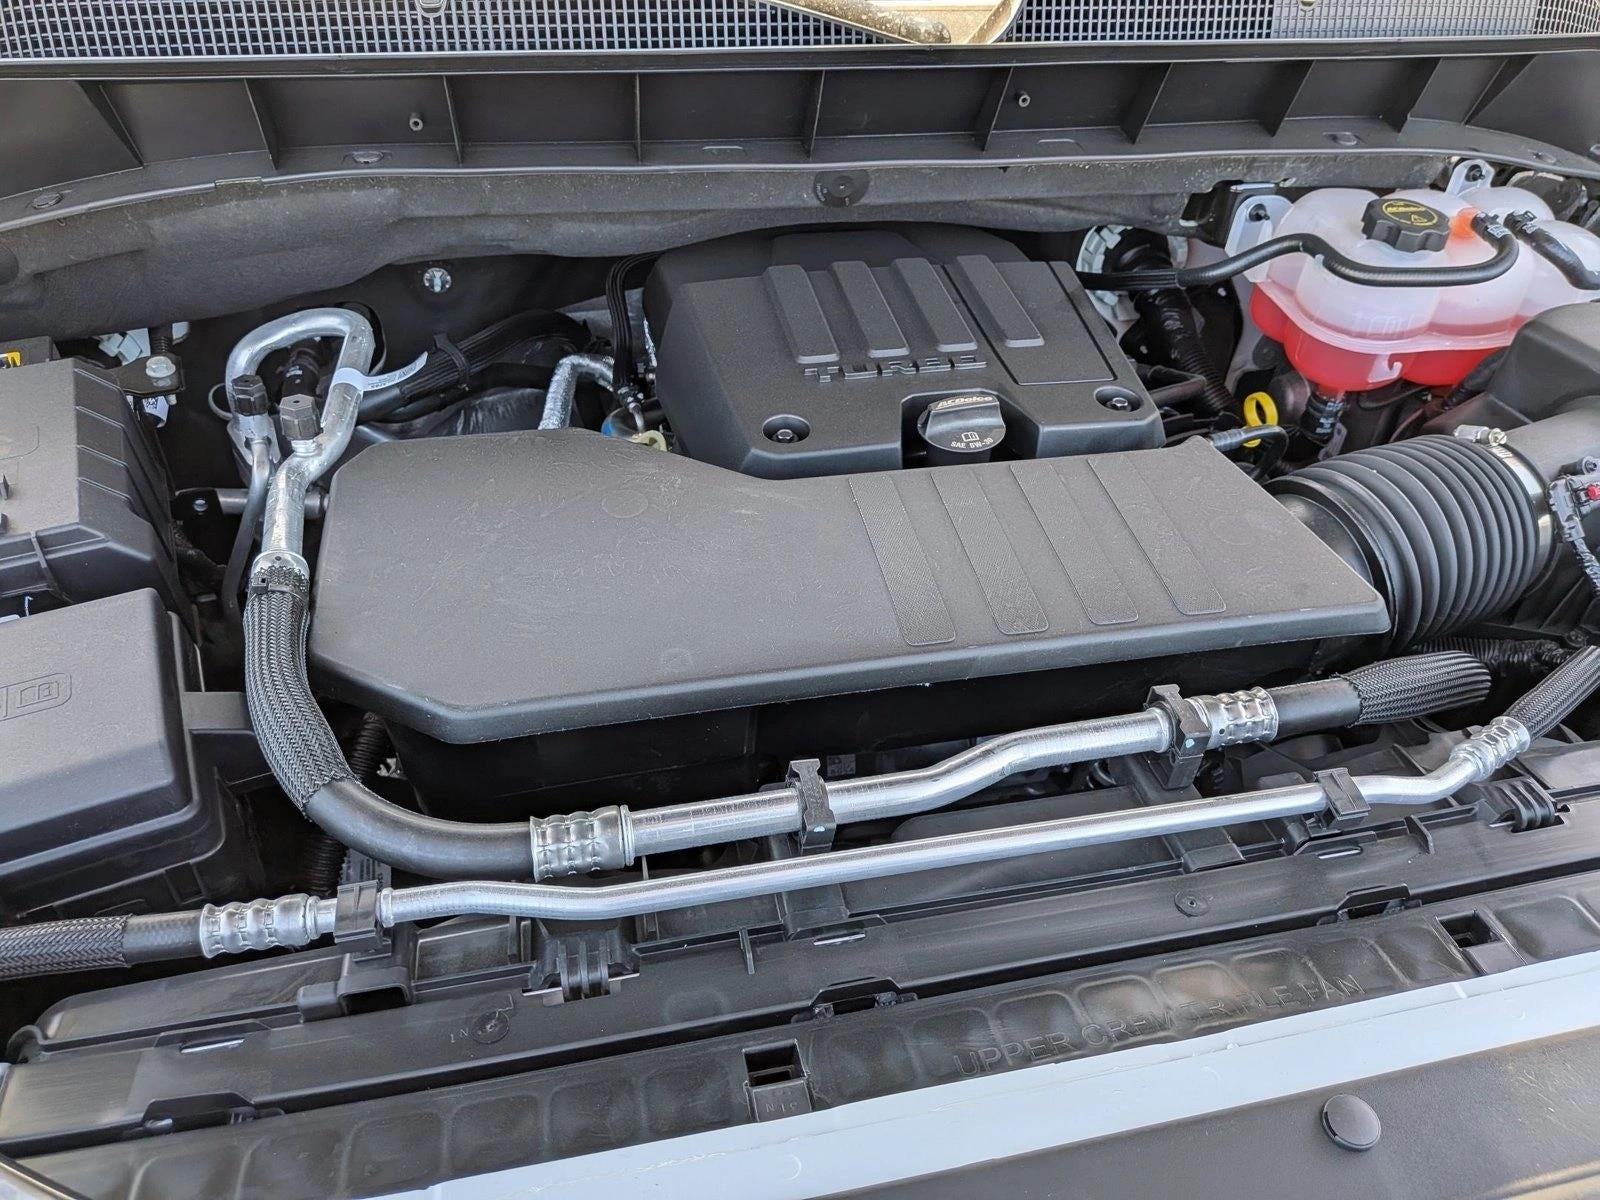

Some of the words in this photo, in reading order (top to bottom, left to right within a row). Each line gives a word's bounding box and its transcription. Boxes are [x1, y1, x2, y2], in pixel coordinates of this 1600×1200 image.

[935, 396, 993, 410] ACDelco
[950, 441, 966, 449] SAE
[952, 1030, 1077, 1077] UPPER
